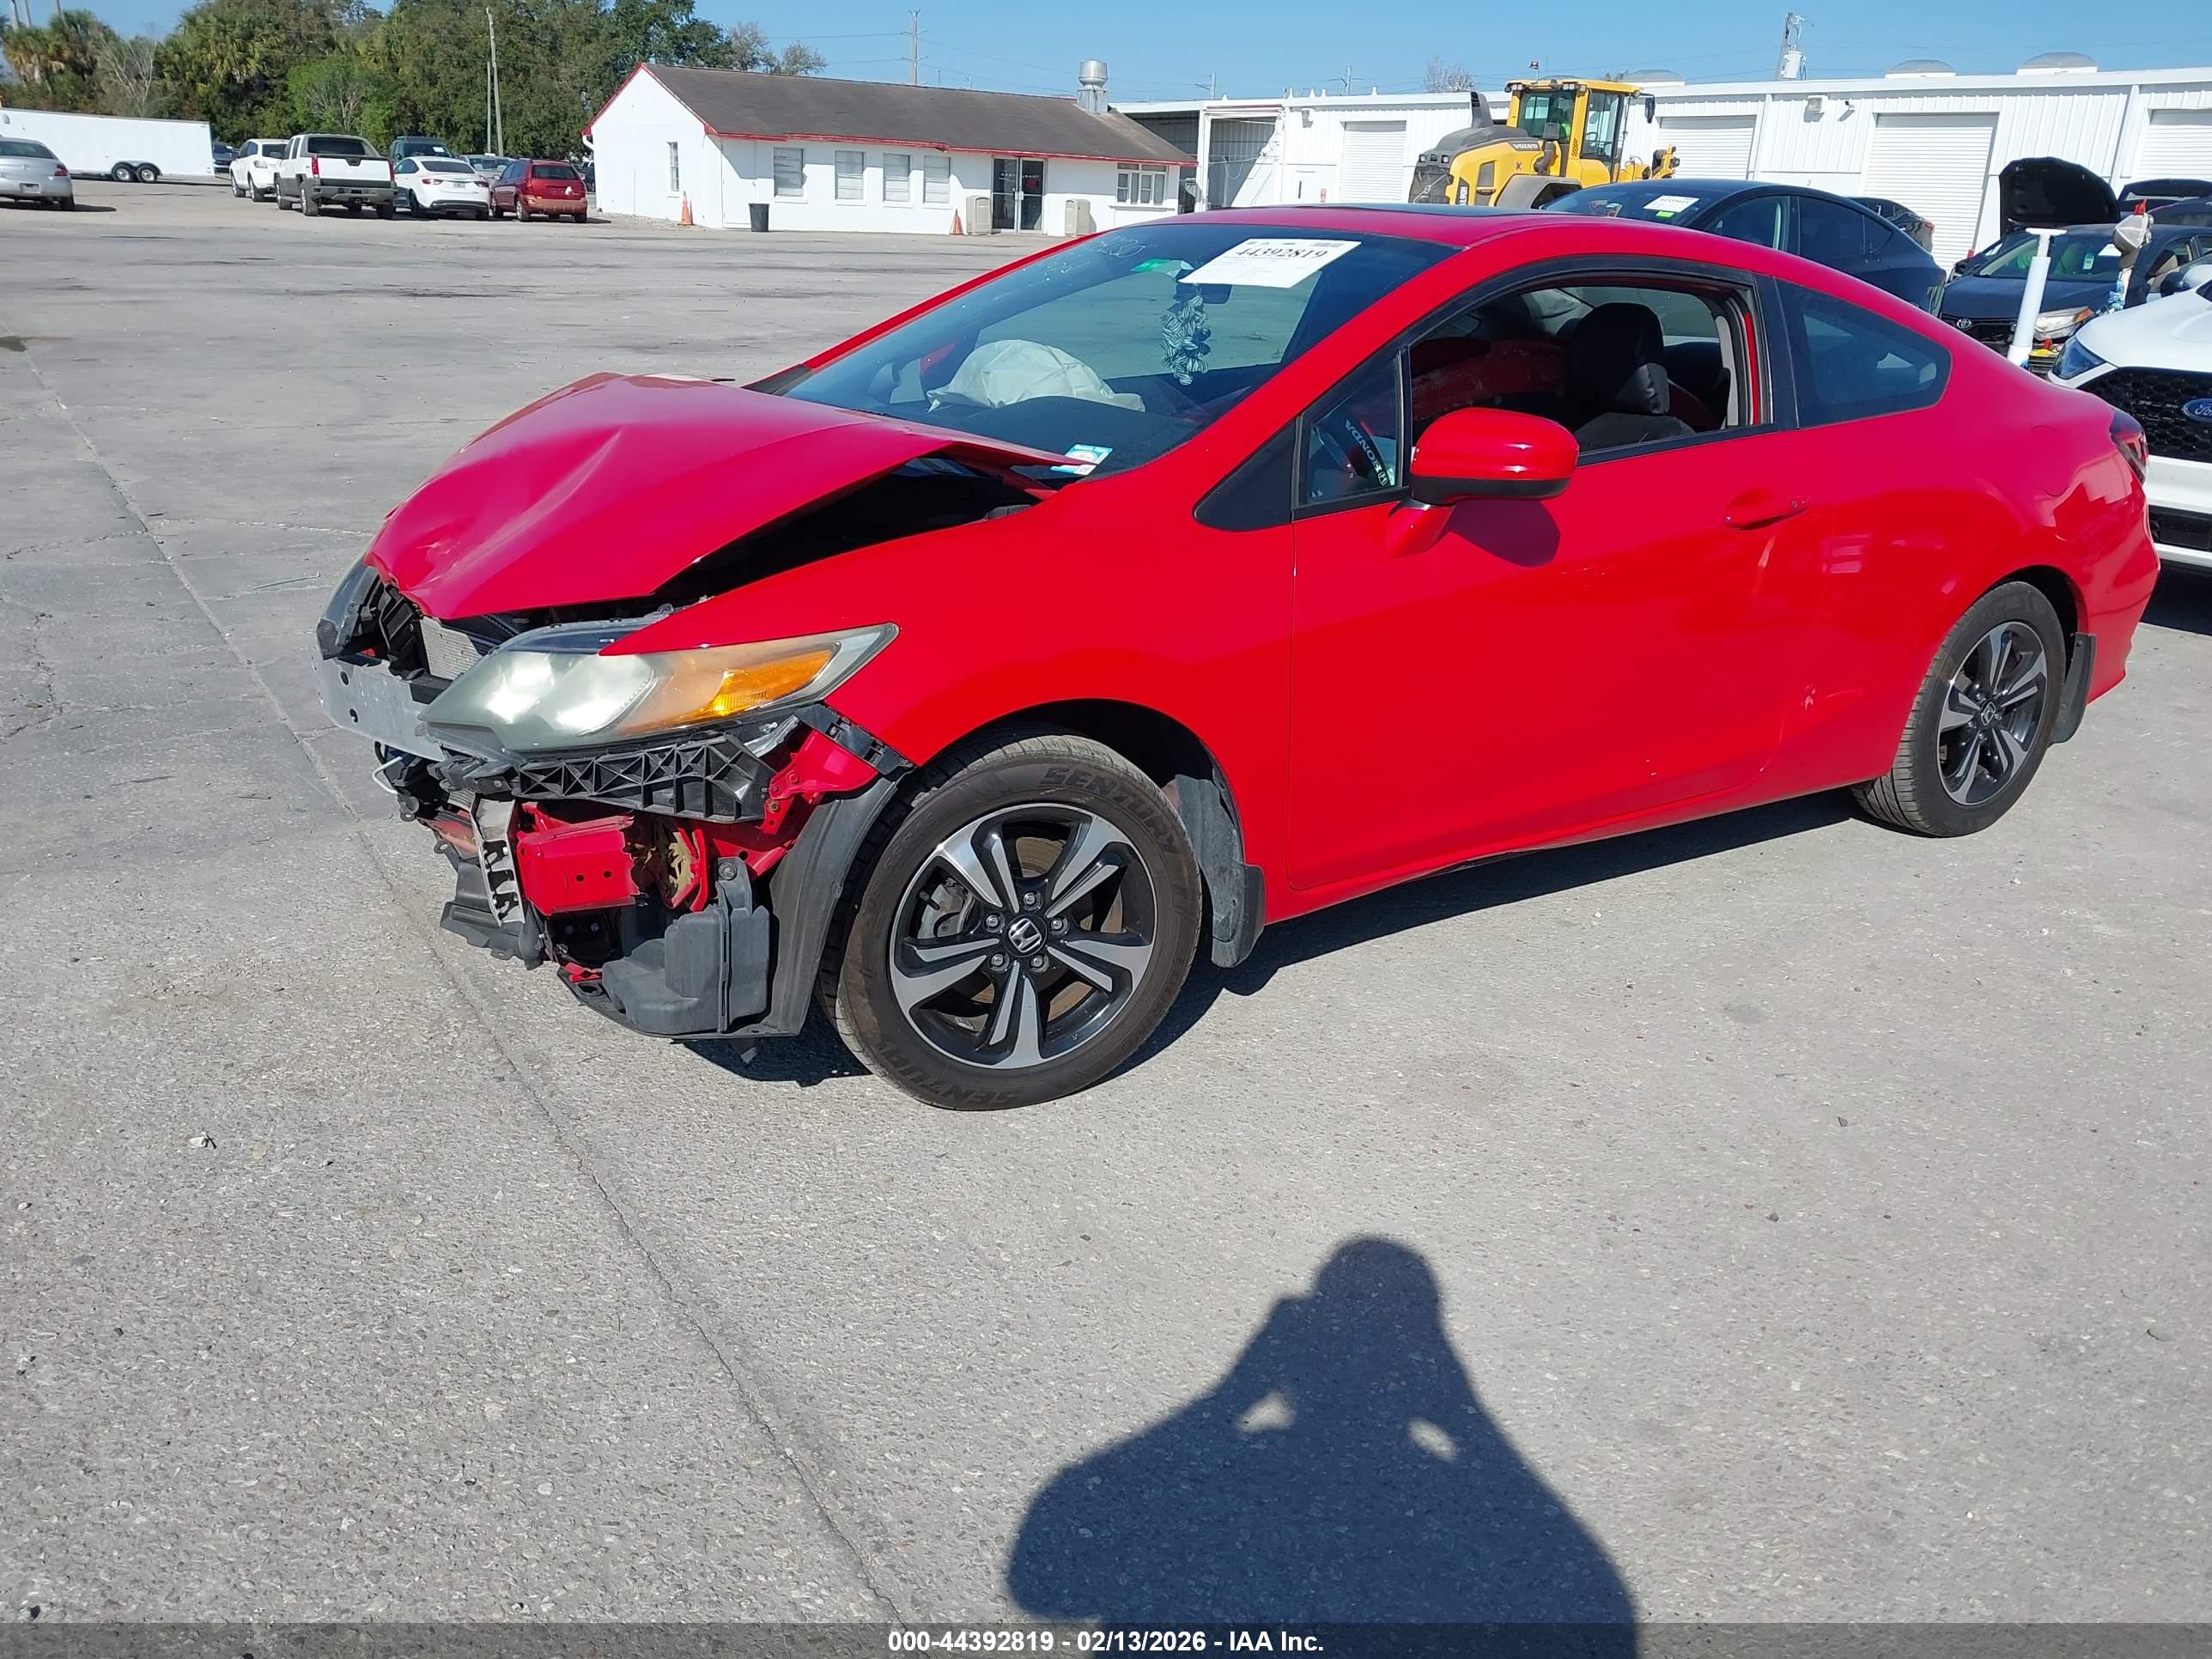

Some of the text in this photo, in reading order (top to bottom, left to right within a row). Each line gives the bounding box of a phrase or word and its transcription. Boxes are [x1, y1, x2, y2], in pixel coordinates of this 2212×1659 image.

[1236, 247, 1328, 258] 44392819
[1344, 418, 1383, 474] HONDA
[1041, 766, 1177, 854] SENTURY
